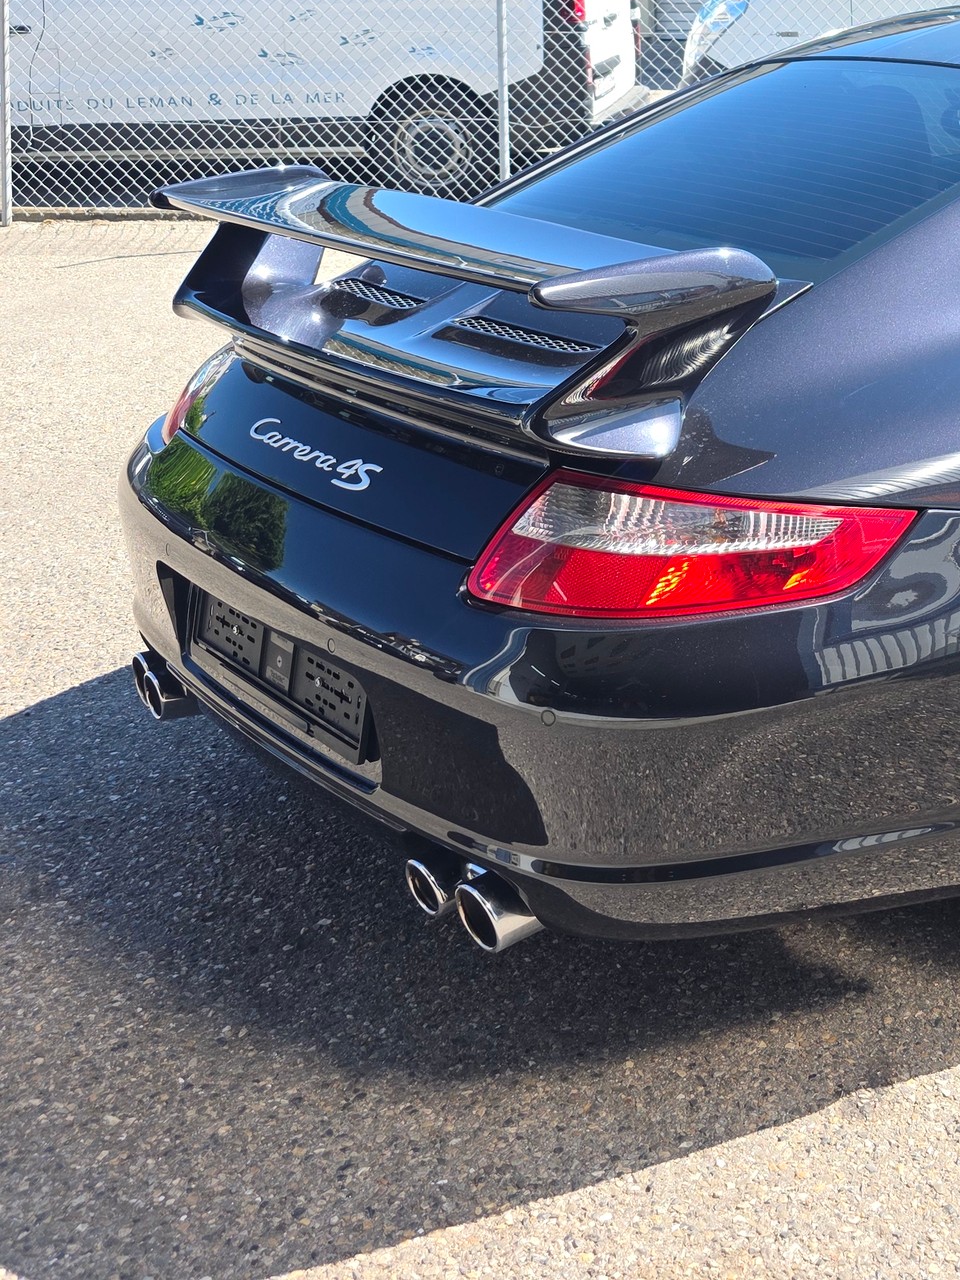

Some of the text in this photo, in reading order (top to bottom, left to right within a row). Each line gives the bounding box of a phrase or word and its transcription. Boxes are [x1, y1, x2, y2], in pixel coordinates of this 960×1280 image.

[87, 98, 113, 110] DU
[126, 95, 193, 108] LEMAN
[208, 92, 222, 106] &
[235, 94, 259, 106] DE
[271, 93, 294, 105] LA
[306, 92, 345, 104] MER
[250, 417, 384, 491] Carrera 4S
